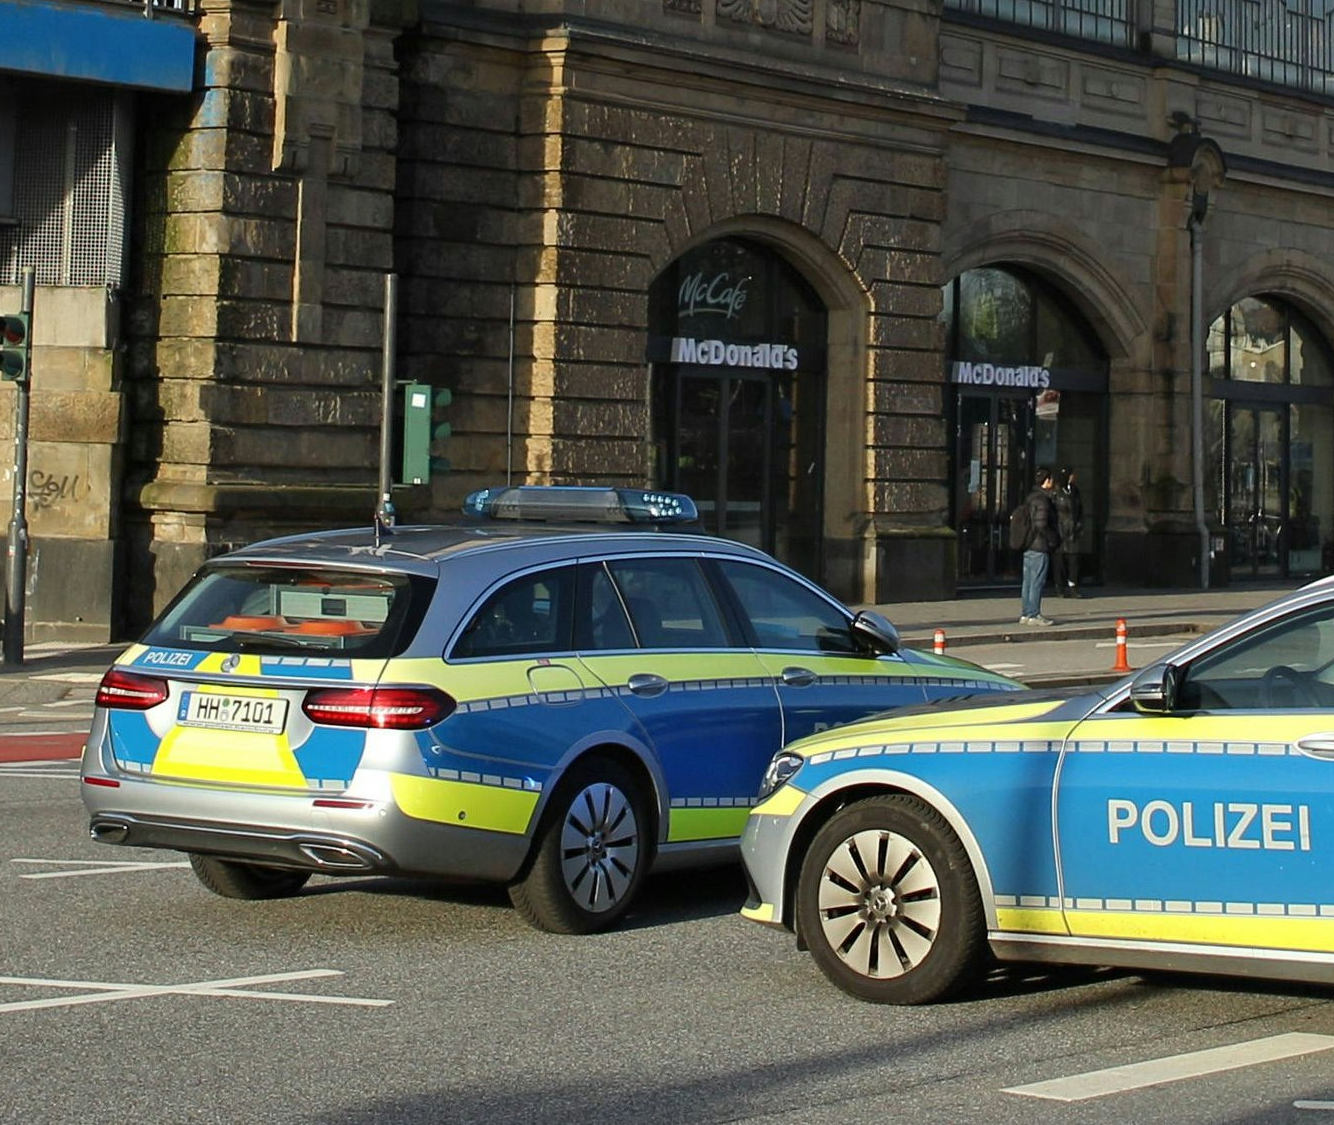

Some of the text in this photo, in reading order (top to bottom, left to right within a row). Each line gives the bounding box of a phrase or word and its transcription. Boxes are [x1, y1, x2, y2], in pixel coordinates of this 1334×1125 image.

[679, 271, 748, 318] McCafé
[672, 337, 798, 371] McDonald's
[953, 361, 1051, 389] McDonald's
[143, 652, 192, 665] POLIZEI
[197, 698, 274, 724] HH 7101
[1107, 798, 1311, 851] POLIZEI
